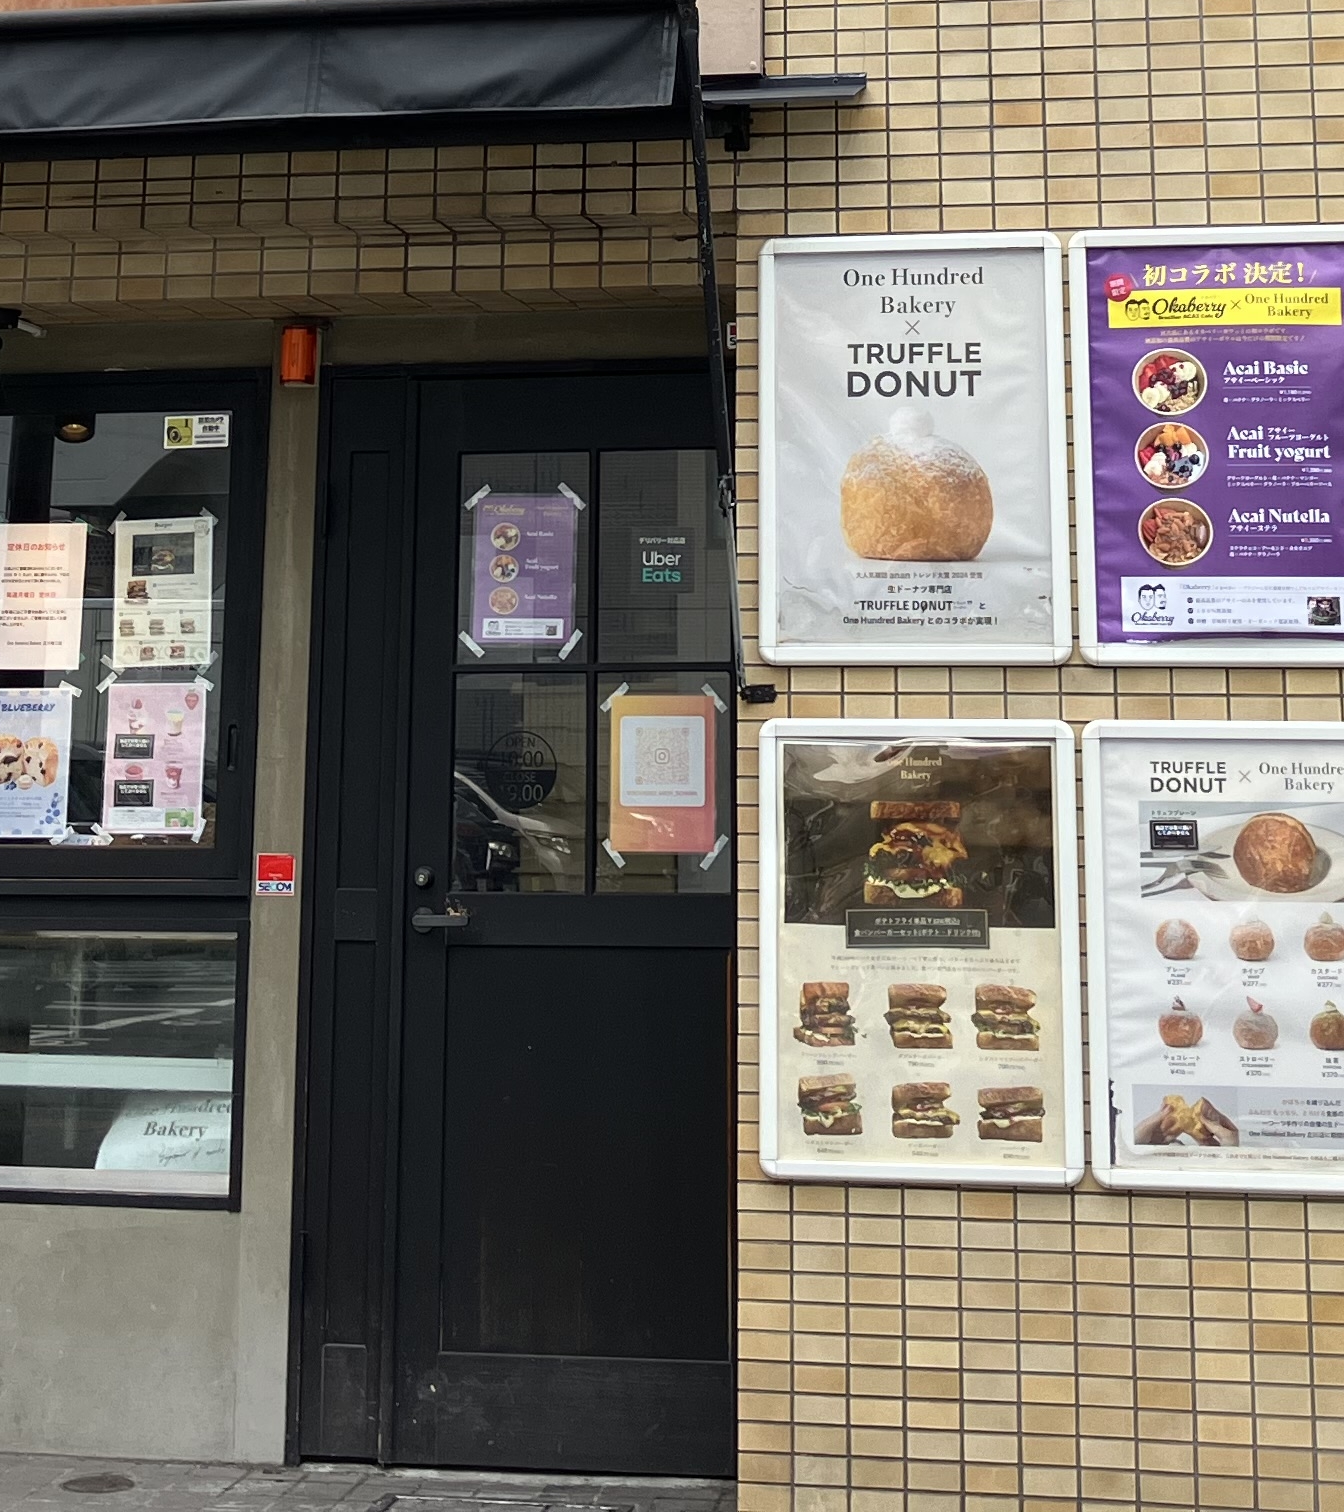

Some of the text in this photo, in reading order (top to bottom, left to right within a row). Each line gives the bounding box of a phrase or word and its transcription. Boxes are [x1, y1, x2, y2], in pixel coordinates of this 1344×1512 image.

[842, 265, 985, 287] One Hundred
[1142, 262, 1238, 287] 初コラボ
[879, 294, 957, 319] Bakery
[1152, 295, 1227, 319] Okaberry
[1244, 294, 1271, 305] One
[1274, 292, 1329, 304] Hundred
[1267, 305, 1313, 319] Bakery
[846, 341, 983, 365] TRUFFLE
[1222, 360, 1309, 376] Acai Basic
[846, 369, 983, 398] DONUT
[1223, 376, 1285, 384] アサイーベーシック
[1226, 425, 1264, 441] Acai
[1267, 433, 1329, 441] フルーツヨーグルト
[1227, 443, 1332, 463] Fruit yogurt
[1228, 508, 1331, 524] Acai Nutella
[7, 542, 66, 552] 定休日のお知らせ
[642, 550, 682, 566] Uber
[641, 567, 682, 583] Eats
[887, 585, 953, 595] 生ドーナツ専門店
[842, 616, 860, 625] One
[860, 616, 896, 625] Hundred
[896, 616, 926, 627] Bakery
[1, 702, 56, 712] BLUEBERRY
[505, 737, 536, 748] OPEN
[905, 756, 943, 768] Hundred
[1149, 761, 1227, 775] TRUFFLE
[1258, 761, 1288, 776] One
[503, 771, 536, 783] CLOSE
[900, 770, 931, 782] Bakery
[1149, 777, 1335, 795] DONUT Bakery
[258, 881, 292, 892] SECOM
[143, 1121, 209, 1142] Bakery
